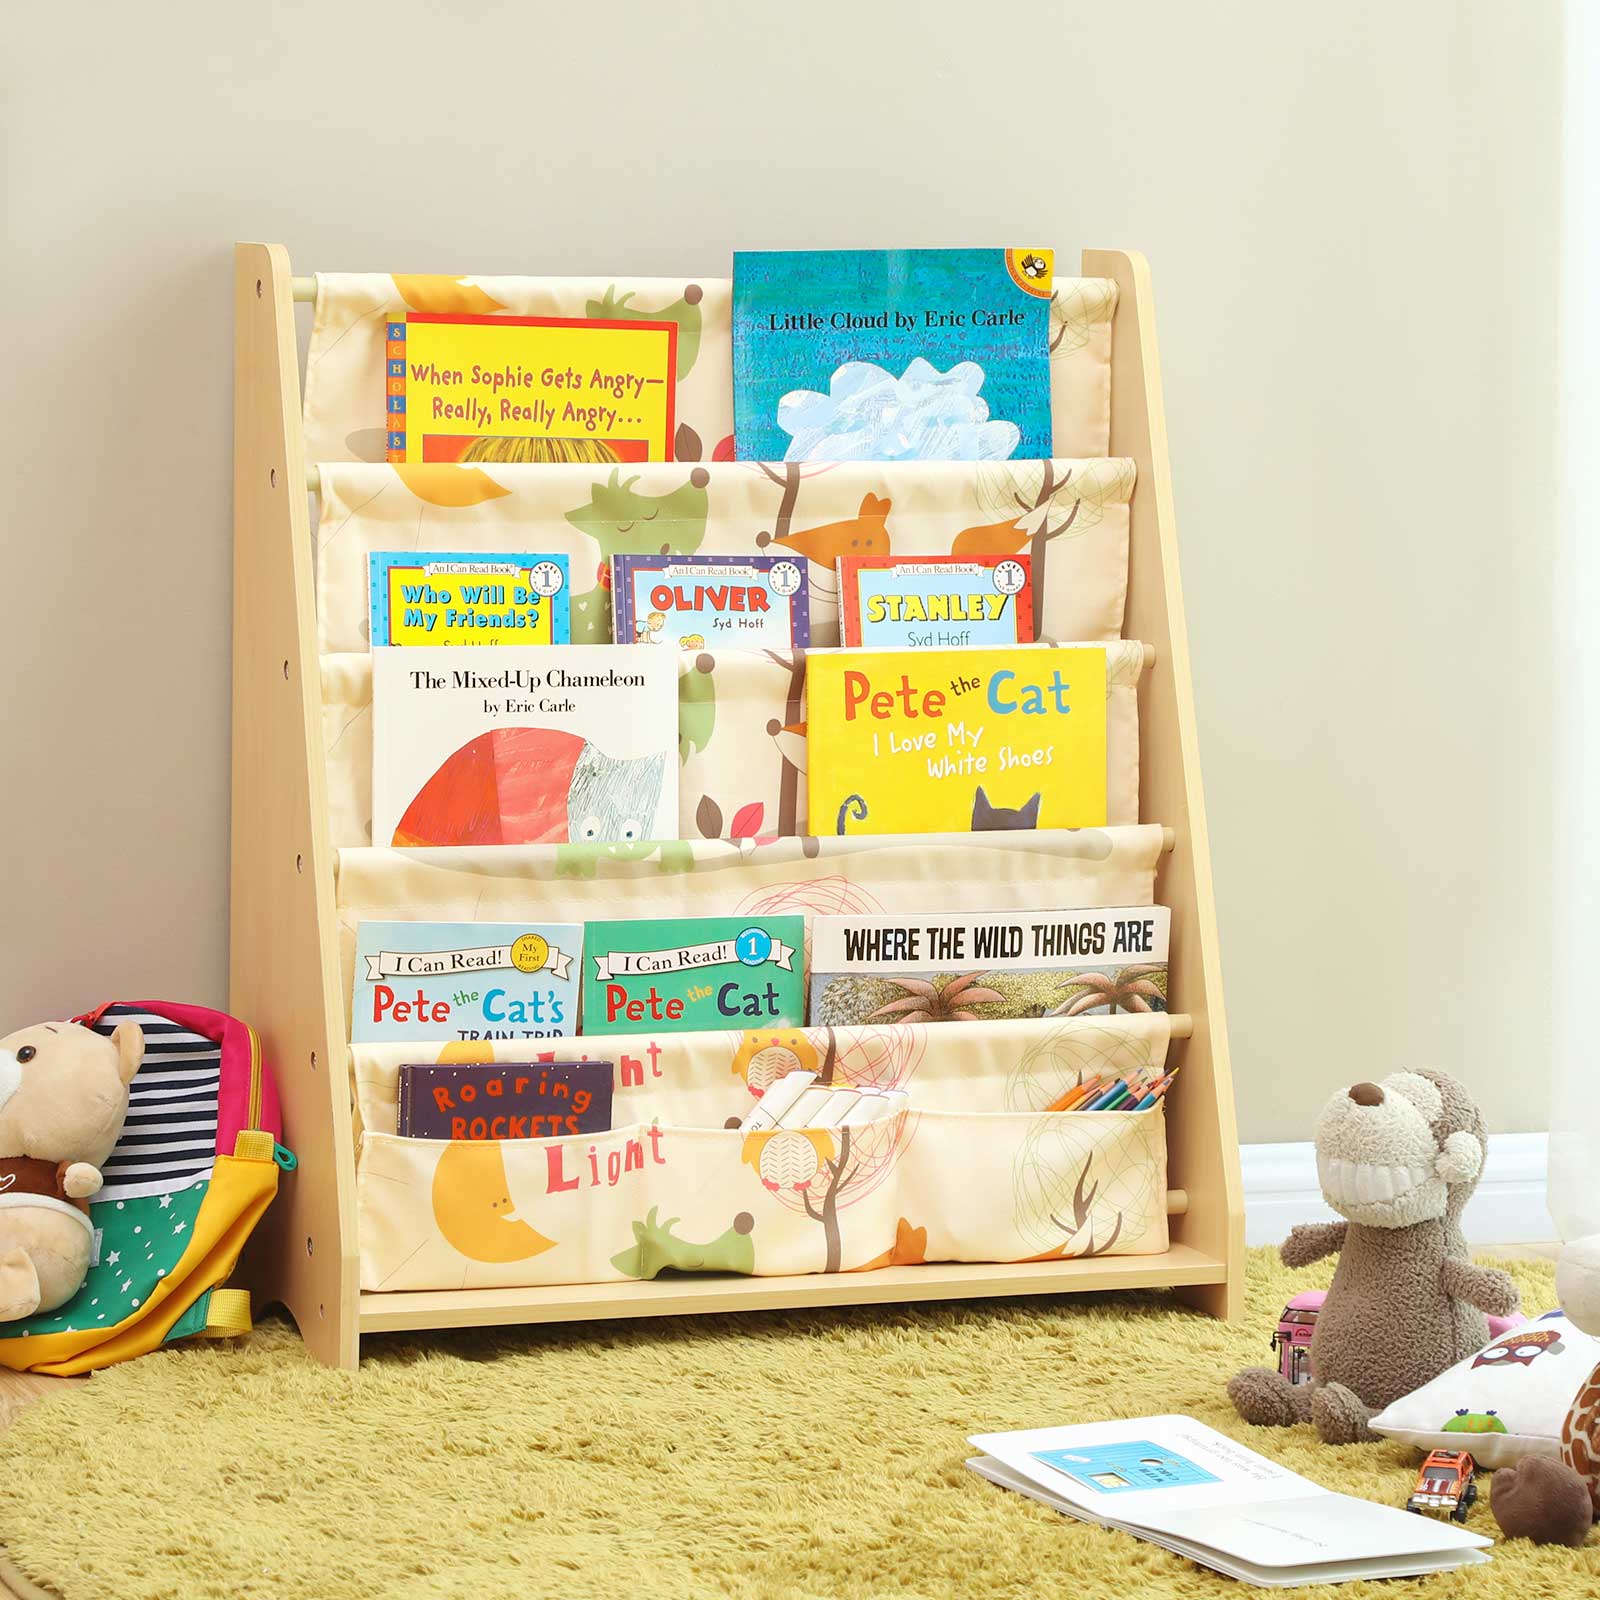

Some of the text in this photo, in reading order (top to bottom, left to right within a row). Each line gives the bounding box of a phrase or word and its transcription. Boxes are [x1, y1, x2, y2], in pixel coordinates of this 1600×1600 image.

[769, 308, 1025, 332] Little Cloud by Eric Carle
[411, 364, 463, 388] When
[471, 364, 533, 394] Sophie
[541, 367, 583, 390] Gets
[432, 396, 492, 428] Really,
[500, 398, 555, 431] Really
[433, 564, 444, 572] An
[450, 564, 466, 573] Can
[469, 564, 488, 573] Read
[541, 570, 552, 587] 1
[673, 567, 684, 575] An
[689, 567, 705, 575] Can
[708, 567, 727, 575] Read
[780, 570, 791, 587] 1
[900, 565, 910, 574] An
[916, 565, 931, 574] Can
[934, 565, 953, 574] Read
[1005, 569, 1015, 586] 1
[401, 585, 451, 604] Who
[460, 586, 505, 605] Will
[513, 587, 541, 605] Be
[650, 585, 771, 613] OLIVER
[867, 593, 1009, 623] STANLEY
[403, 609, 539, 632] My Friends?
[712, 617, 764, 630] Syd Hoff
[908, 630, 971, 647] Syd Hoff
[410, 669, 645, 693] The Mixed-Up Chameleon
[844, 670, 1071, 721] Pete the Cat
[484, 698, 576, 717] by Eric Carle
[873, 721, 984, 757] I Love My
[927, 745, 1054, 779] White Shoes
[523, 943, 537, 954] My
[748, 936, 758, 956] 1
[844, 919, 1154, 962] WHERE THE WILD THINGS ARE
[394, 950, 502, 973] I Can Read!
[519, 953, 540, 962] First
[623, 956, 631, 972] I
[636, 956, 672, 972] Can
[676, 945, 727, 967] Read!
[373, 984, 564, 1024] Pete the Cat's
[606, 982, 780, 1023] Pete the Cat
[432, 1071, 593, 1114] Roaring
[451, 1115, 580, 1140] ROCKETS
